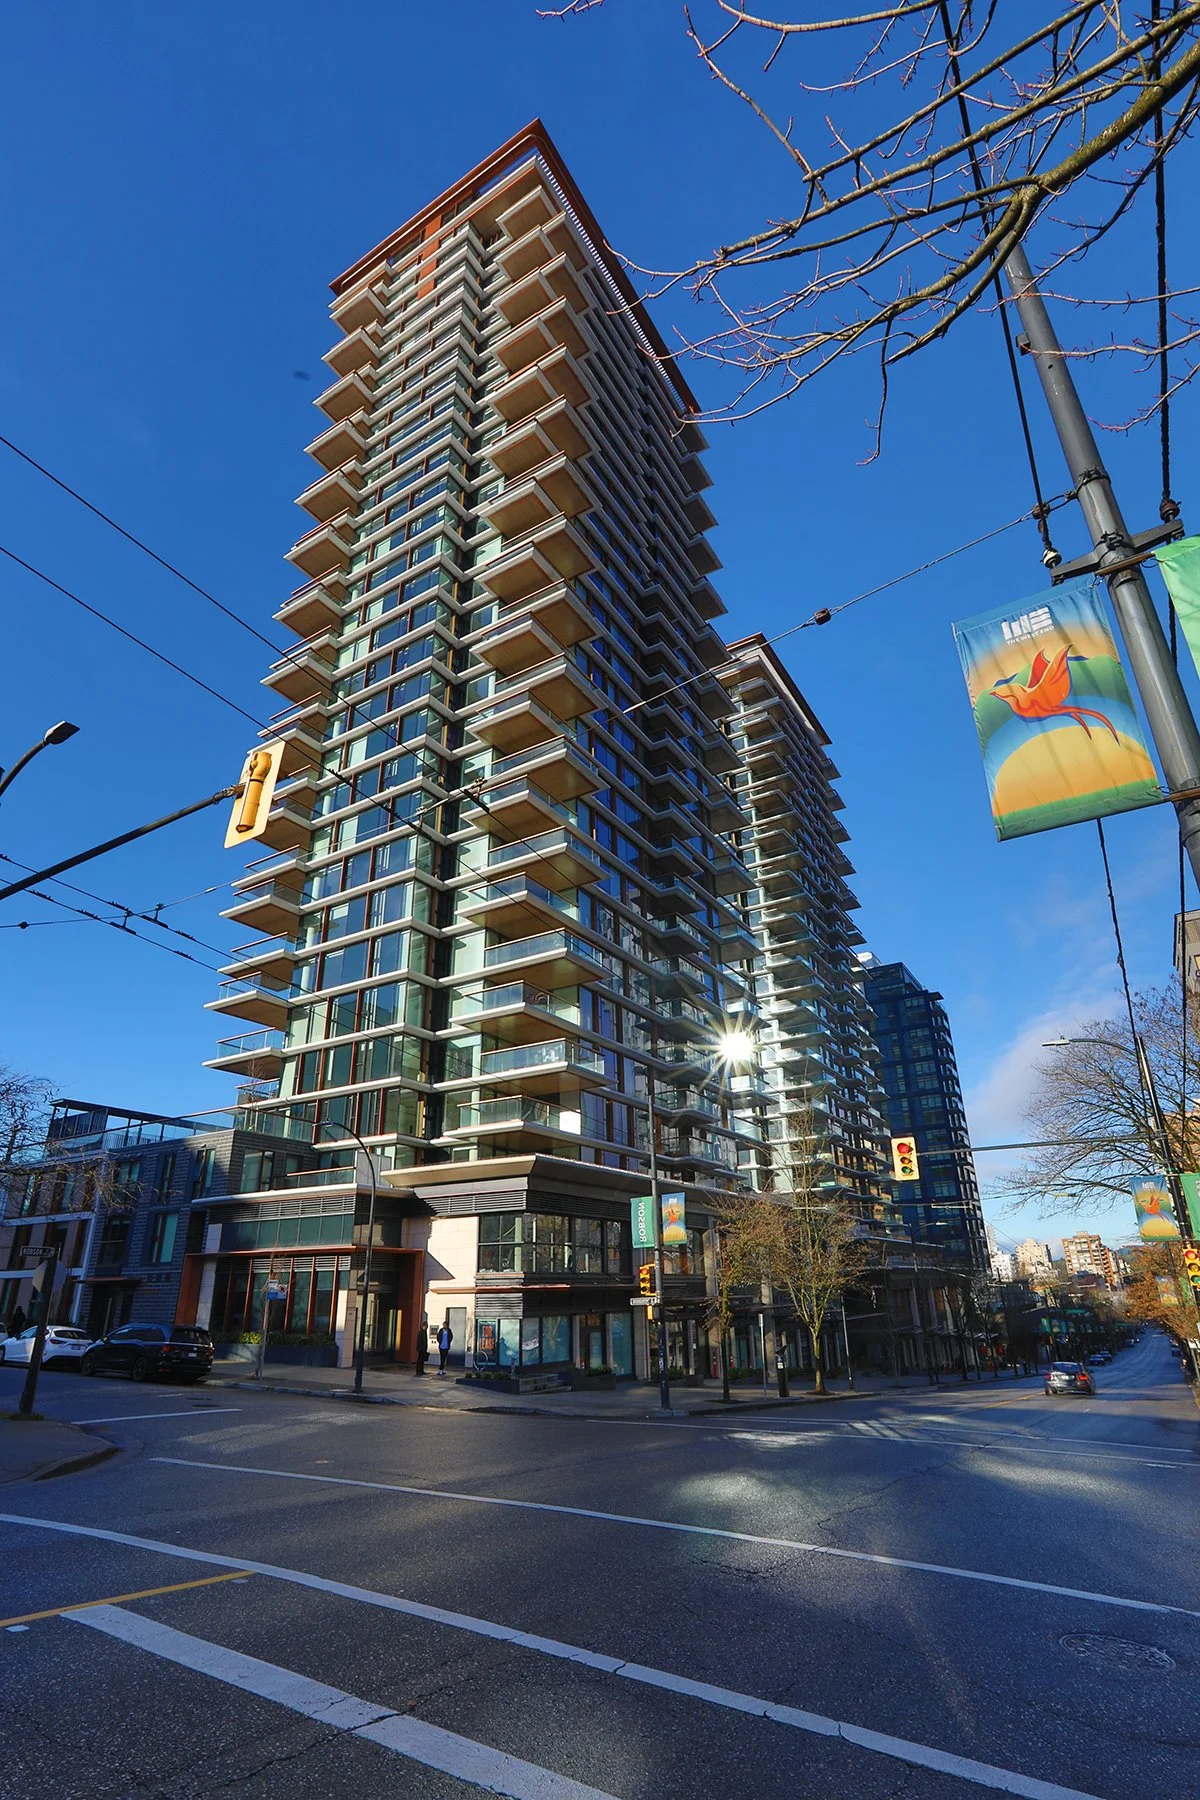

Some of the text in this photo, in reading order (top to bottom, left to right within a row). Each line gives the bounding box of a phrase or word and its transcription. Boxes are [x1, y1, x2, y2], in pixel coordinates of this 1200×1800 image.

[1006, 625, 1055, 646] THE WEST END
[23, 1248, 43, 1256] ROBSON
